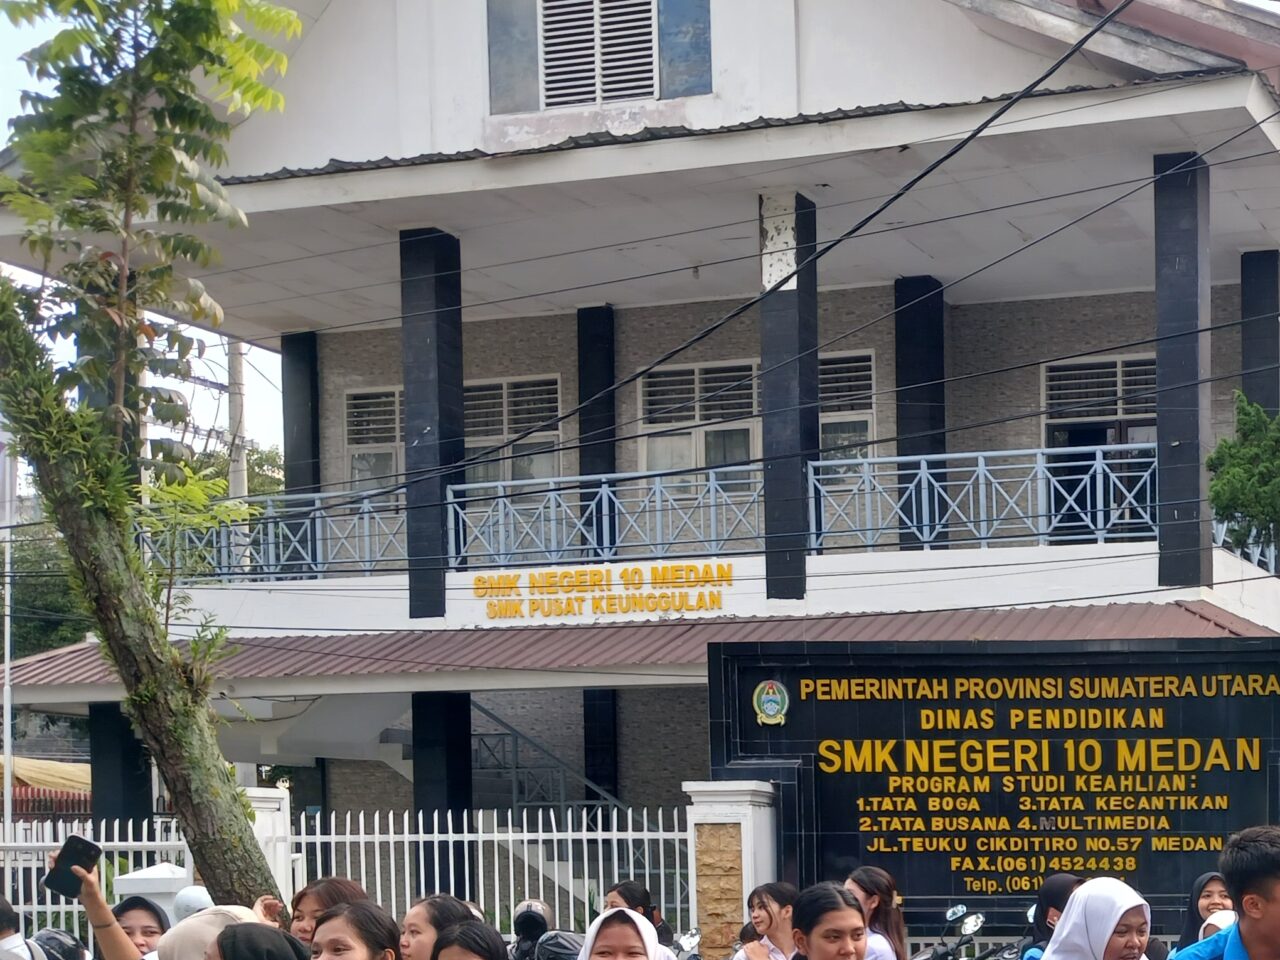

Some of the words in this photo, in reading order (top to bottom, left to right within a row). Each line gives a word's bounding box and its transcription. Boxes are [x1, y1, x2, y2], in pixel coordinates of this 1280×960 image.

[472, 574, 521, 598] SMK
[528, 568, 612, 595] NEGERI
[619, 567, 644, 591] 10
[650, 563, 734, 590] MEDAN
[486, 599, 525, 620] SMK
[528, 595, 586, 618] PUSAT
[591, 590, 723, 615] KEUNGGULAN
[800, 678, 948, 701] PEMERINTAH
[955, 677, 1063, 700] PROVINSI
[1069, 676, 1198, 699] SUMATERA
[919, 708, 995, 730] DINAS
[1010, 707, 1165, 730] PENDIDIKAN
[818, 739, 899, 774] SMK
[905, 739, 1051, 774] NEGERI
[1063, 738, 1102, 773] 10
[1117, 738, 1261, 772] MEDAN
[888, 775, 990, 793] PROGRAM
[1002, 775, 1066, 793] STUDI
[1075, 774, 1197, 792] KEAHLIAN:
[857, 796, 918, 812] 1.TATA
[928, 796, 982, 811] BOGA
[1018, 796, 1085, 811] 3.TATA
[1095, 795, 1229, 811] KECANTIKAN
[859, 816, 926, 832] 2.TATA
[931, 816, 1011, 831] BUSANA
[1017, 815, 1171, 831] 4.MULTIMEDIA
[867, 837, 968, 852] JL.TEUKU
[976, 837, 1078, 852] CIKDITIRO
[1085, 837, 1143, 852] NO.57
[1151, 836, 1224, 852] MEDAN
